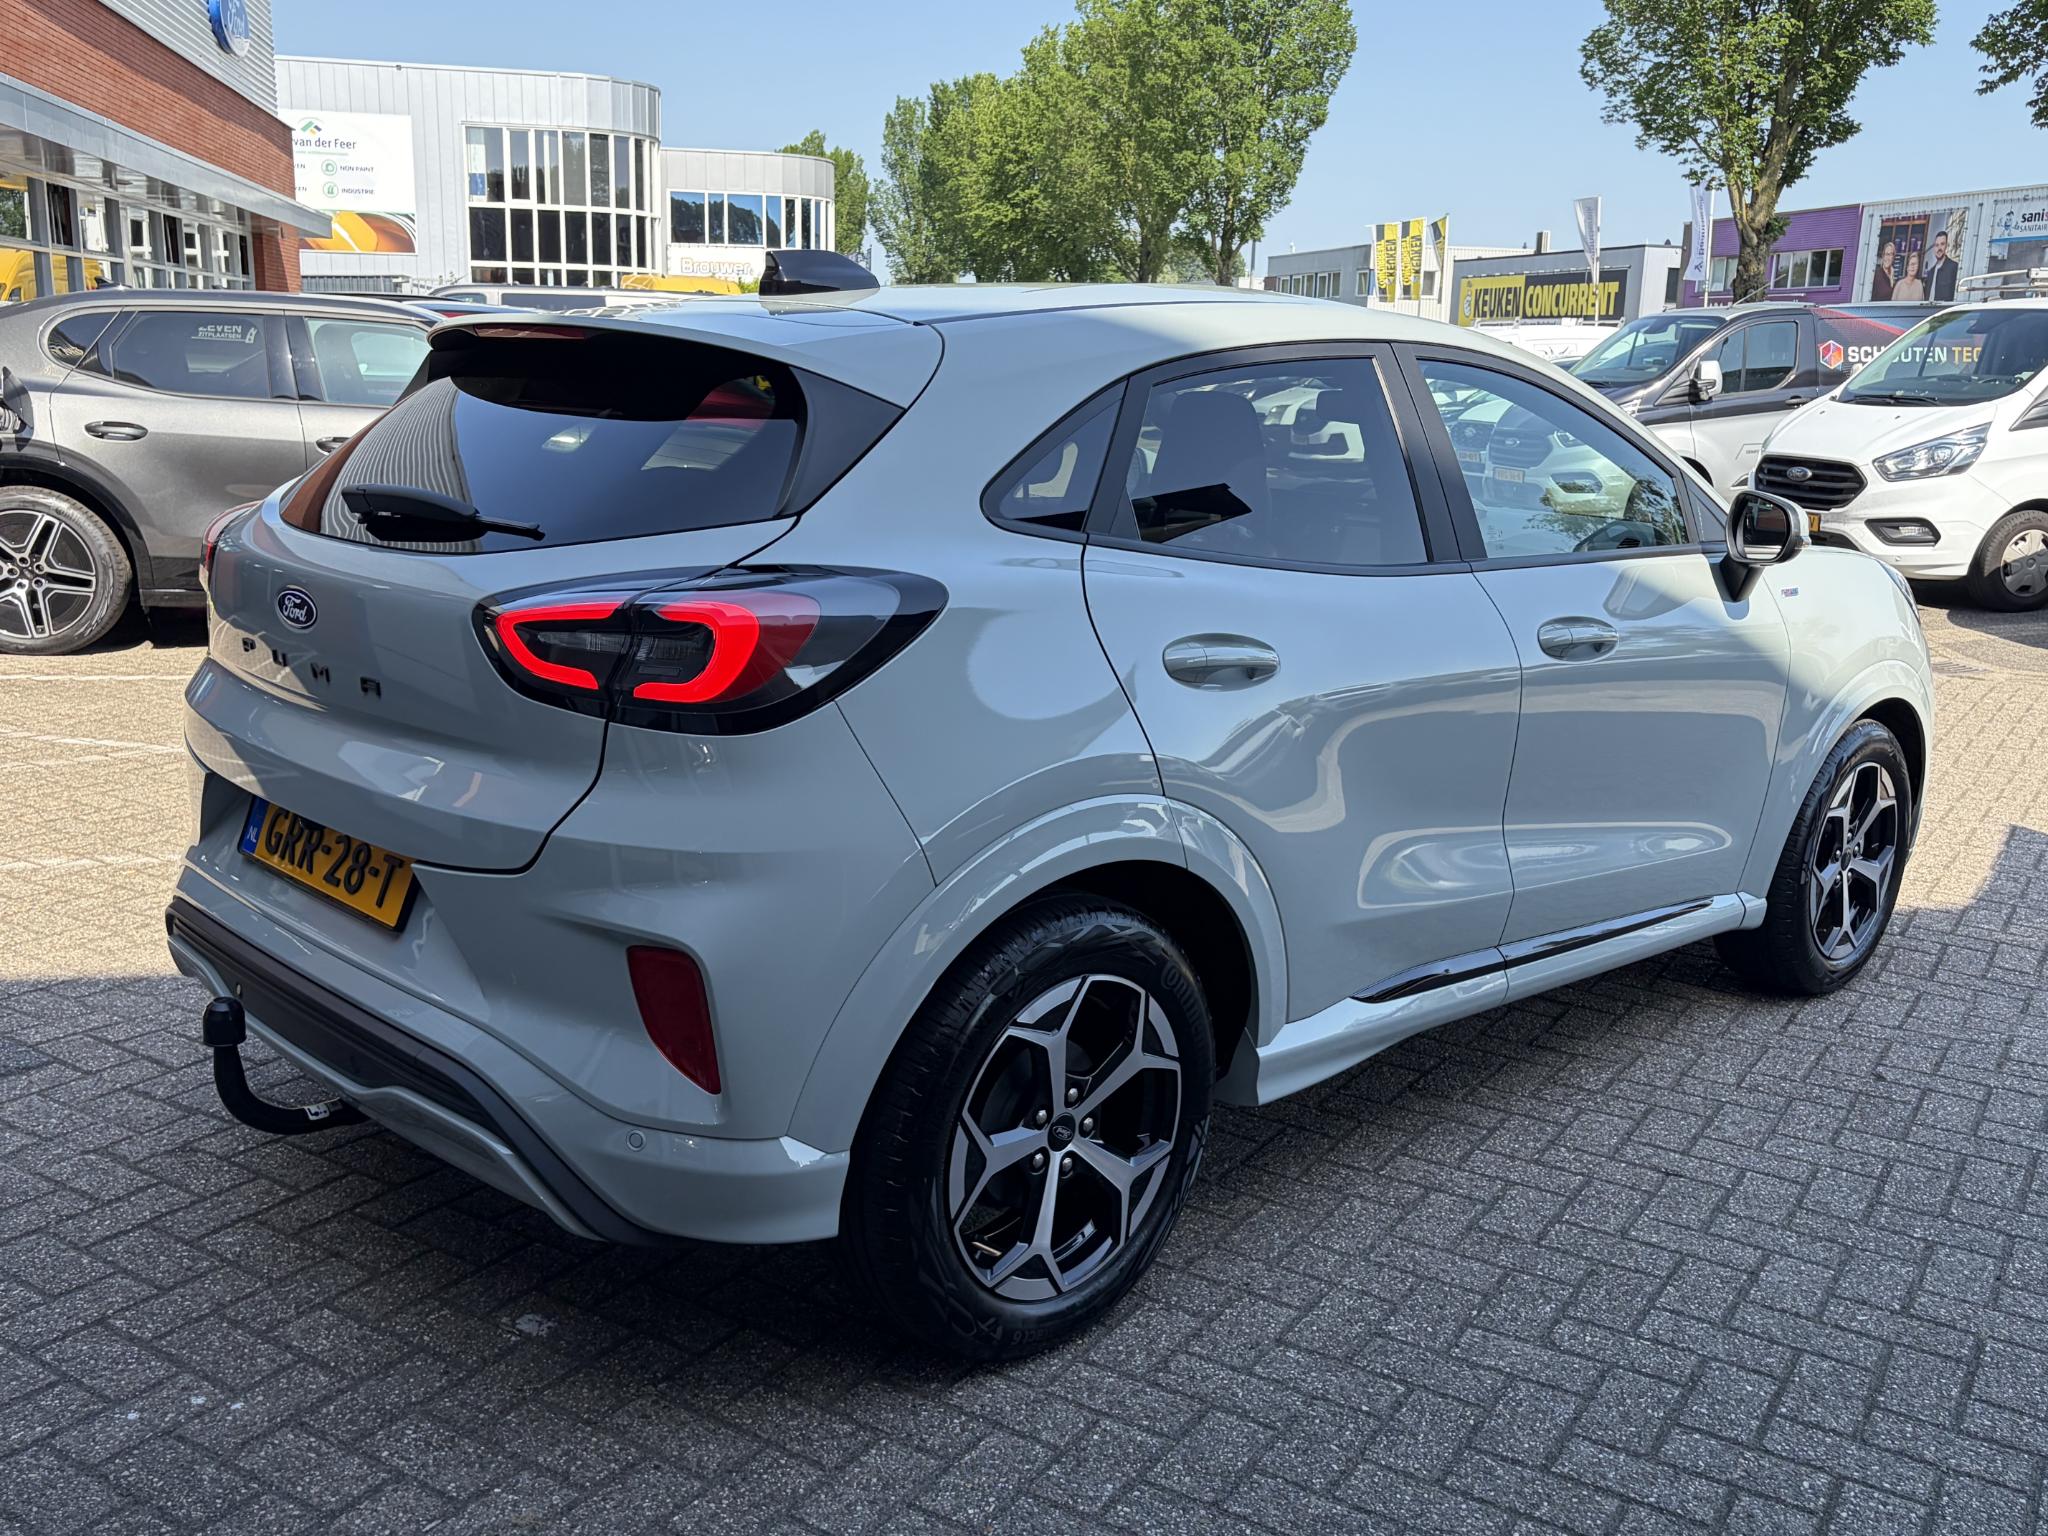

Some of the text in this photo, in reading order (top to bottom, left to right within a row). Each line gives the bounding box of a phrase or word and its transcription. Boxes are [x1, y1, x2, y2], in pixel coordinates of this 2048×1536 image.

[293, 137, 357, 150] van der Feer
[681, 257, 751, 275] Brouwer
[1474, 281, 1620, 318] KEUKEN CONCURRENT
[283, 594, 307, 622] Ford
[242, 637, 382, 700] PUMA
[247, 825, 257, 843] NL
[264, 806, 405, 909] GRR-28-T
